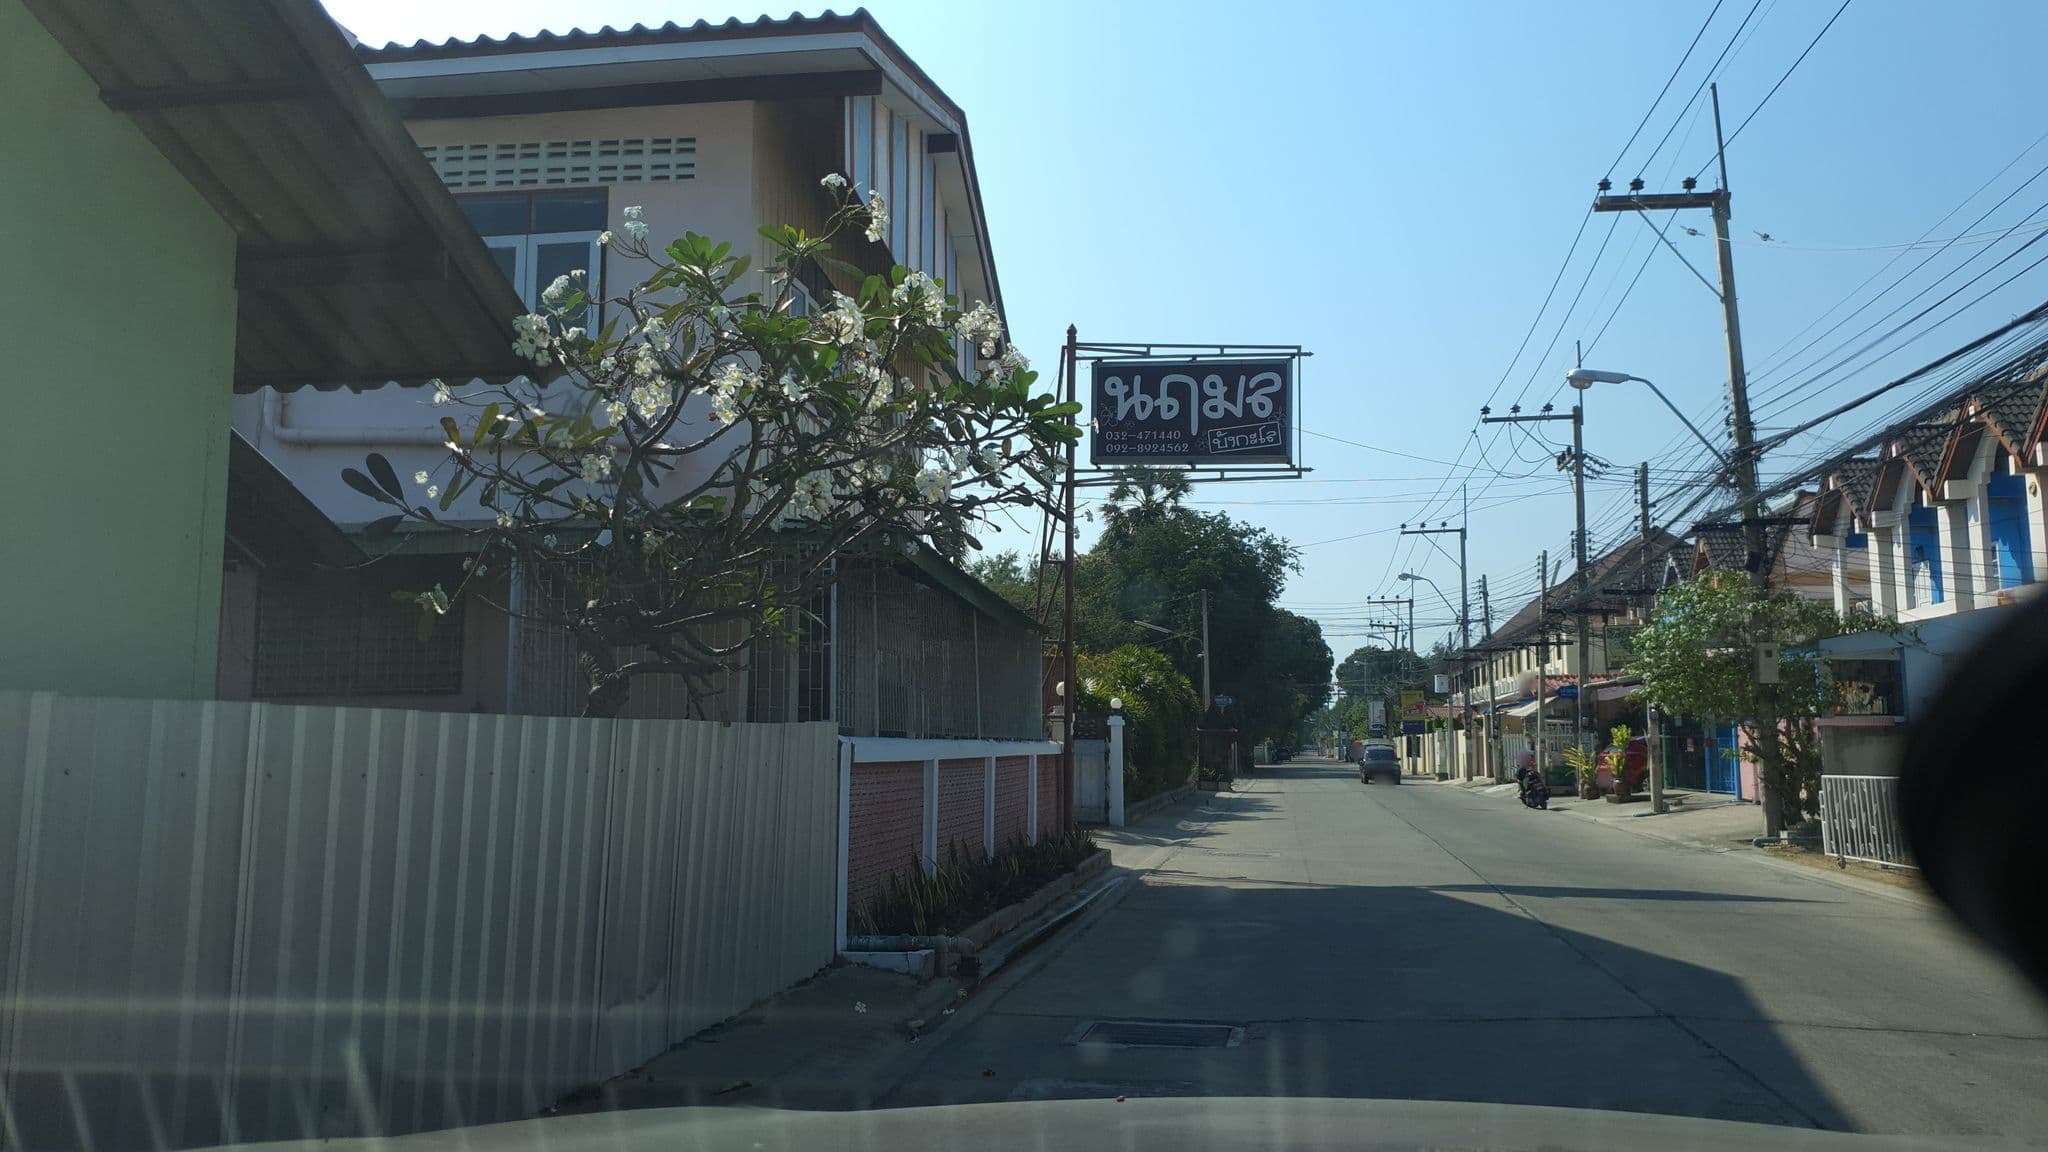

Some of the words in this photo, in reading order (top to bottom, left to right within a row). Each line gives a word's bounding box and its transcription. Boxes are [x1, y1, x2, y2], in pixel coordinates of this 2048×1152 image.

[1106, 430, 1181, 441] 032-471440
[1212, 425, 1277, 450] บังกะโล
[1106, 442, 1190, 453] 092-8924562
